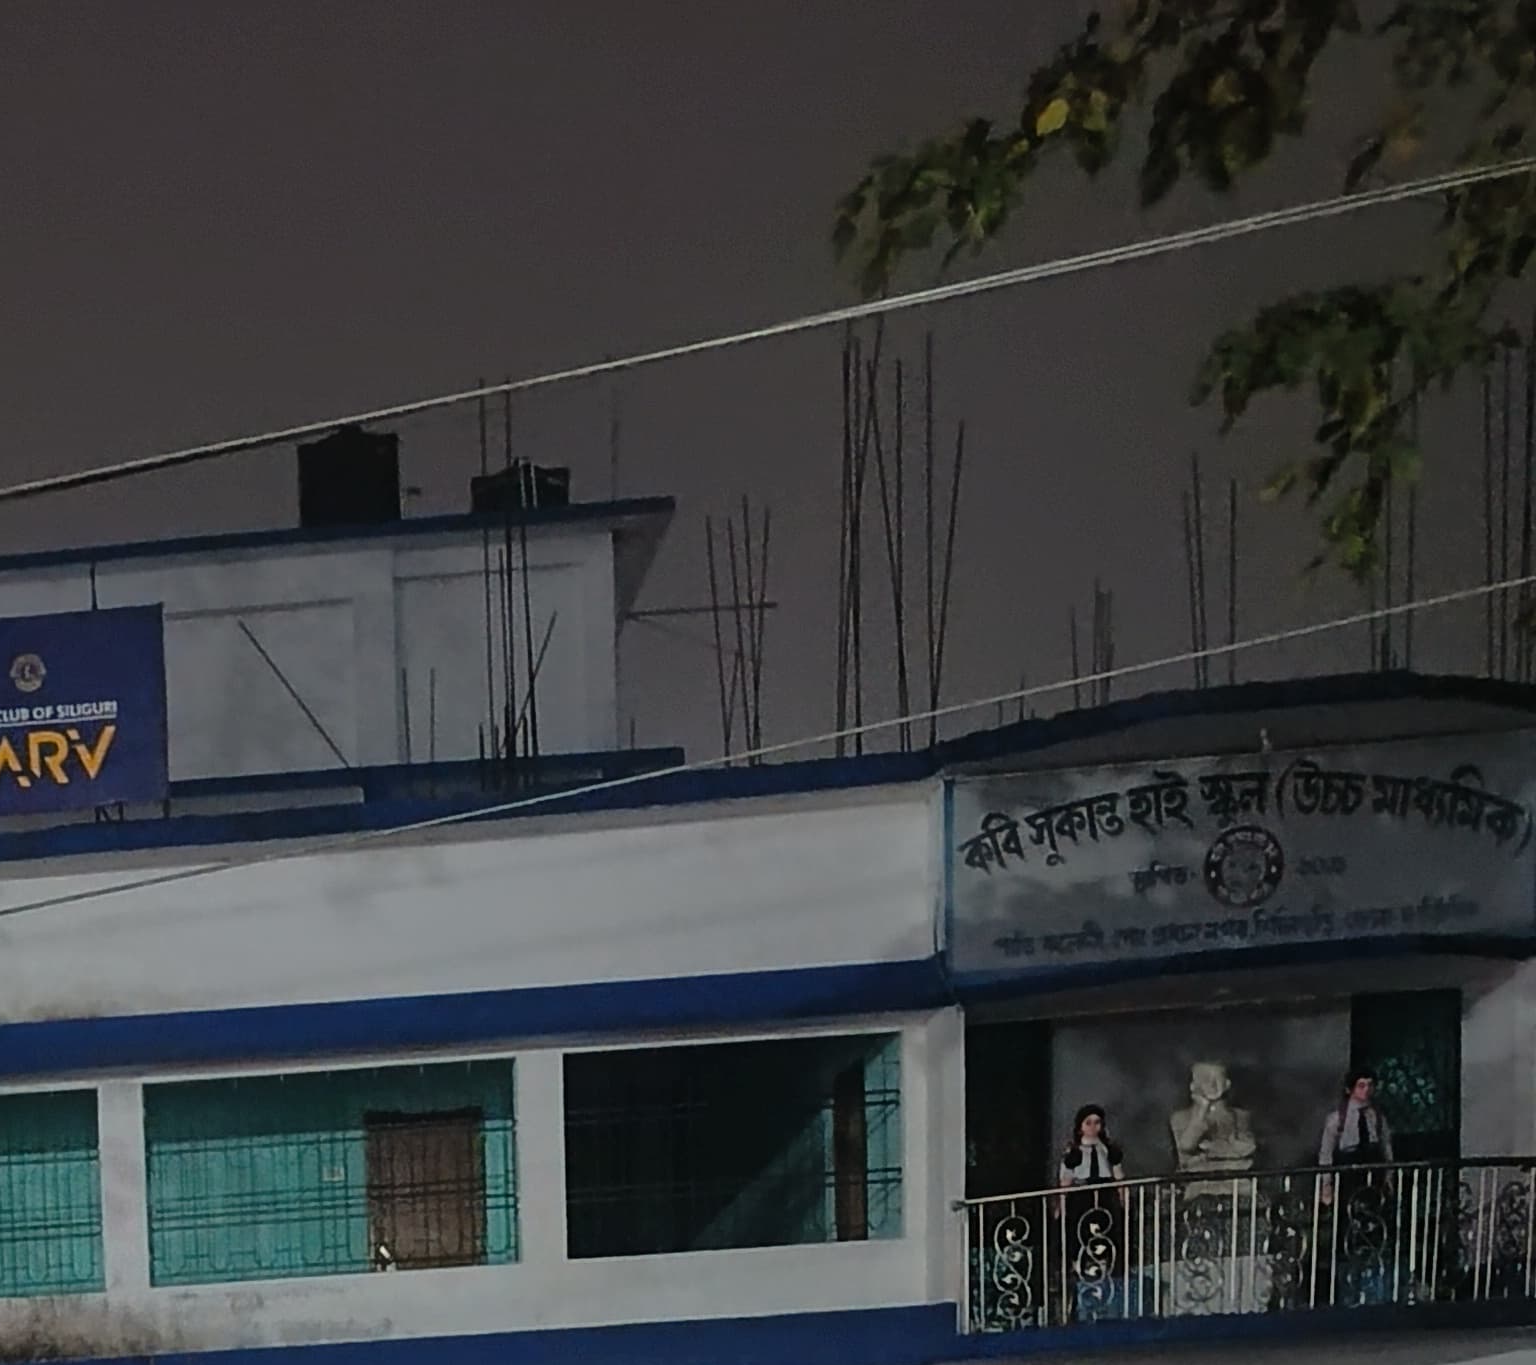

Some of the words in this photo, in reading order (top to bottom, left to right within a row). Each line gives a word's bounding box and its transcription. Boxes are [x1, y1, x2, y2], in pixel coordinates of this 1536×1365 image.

[32, 705, 55, 720] OF
[56, 700, 117, 719] SILIGURI
[957, 812, 1024, 873] কবি
[1024, 791, 1126, 866] সুকান্ত
[1126, 769, 1195, 836] হাই
[1199, 772, 1271, 828] স্কুল
[1275, 758, 1366, 819] (উচ্চ
